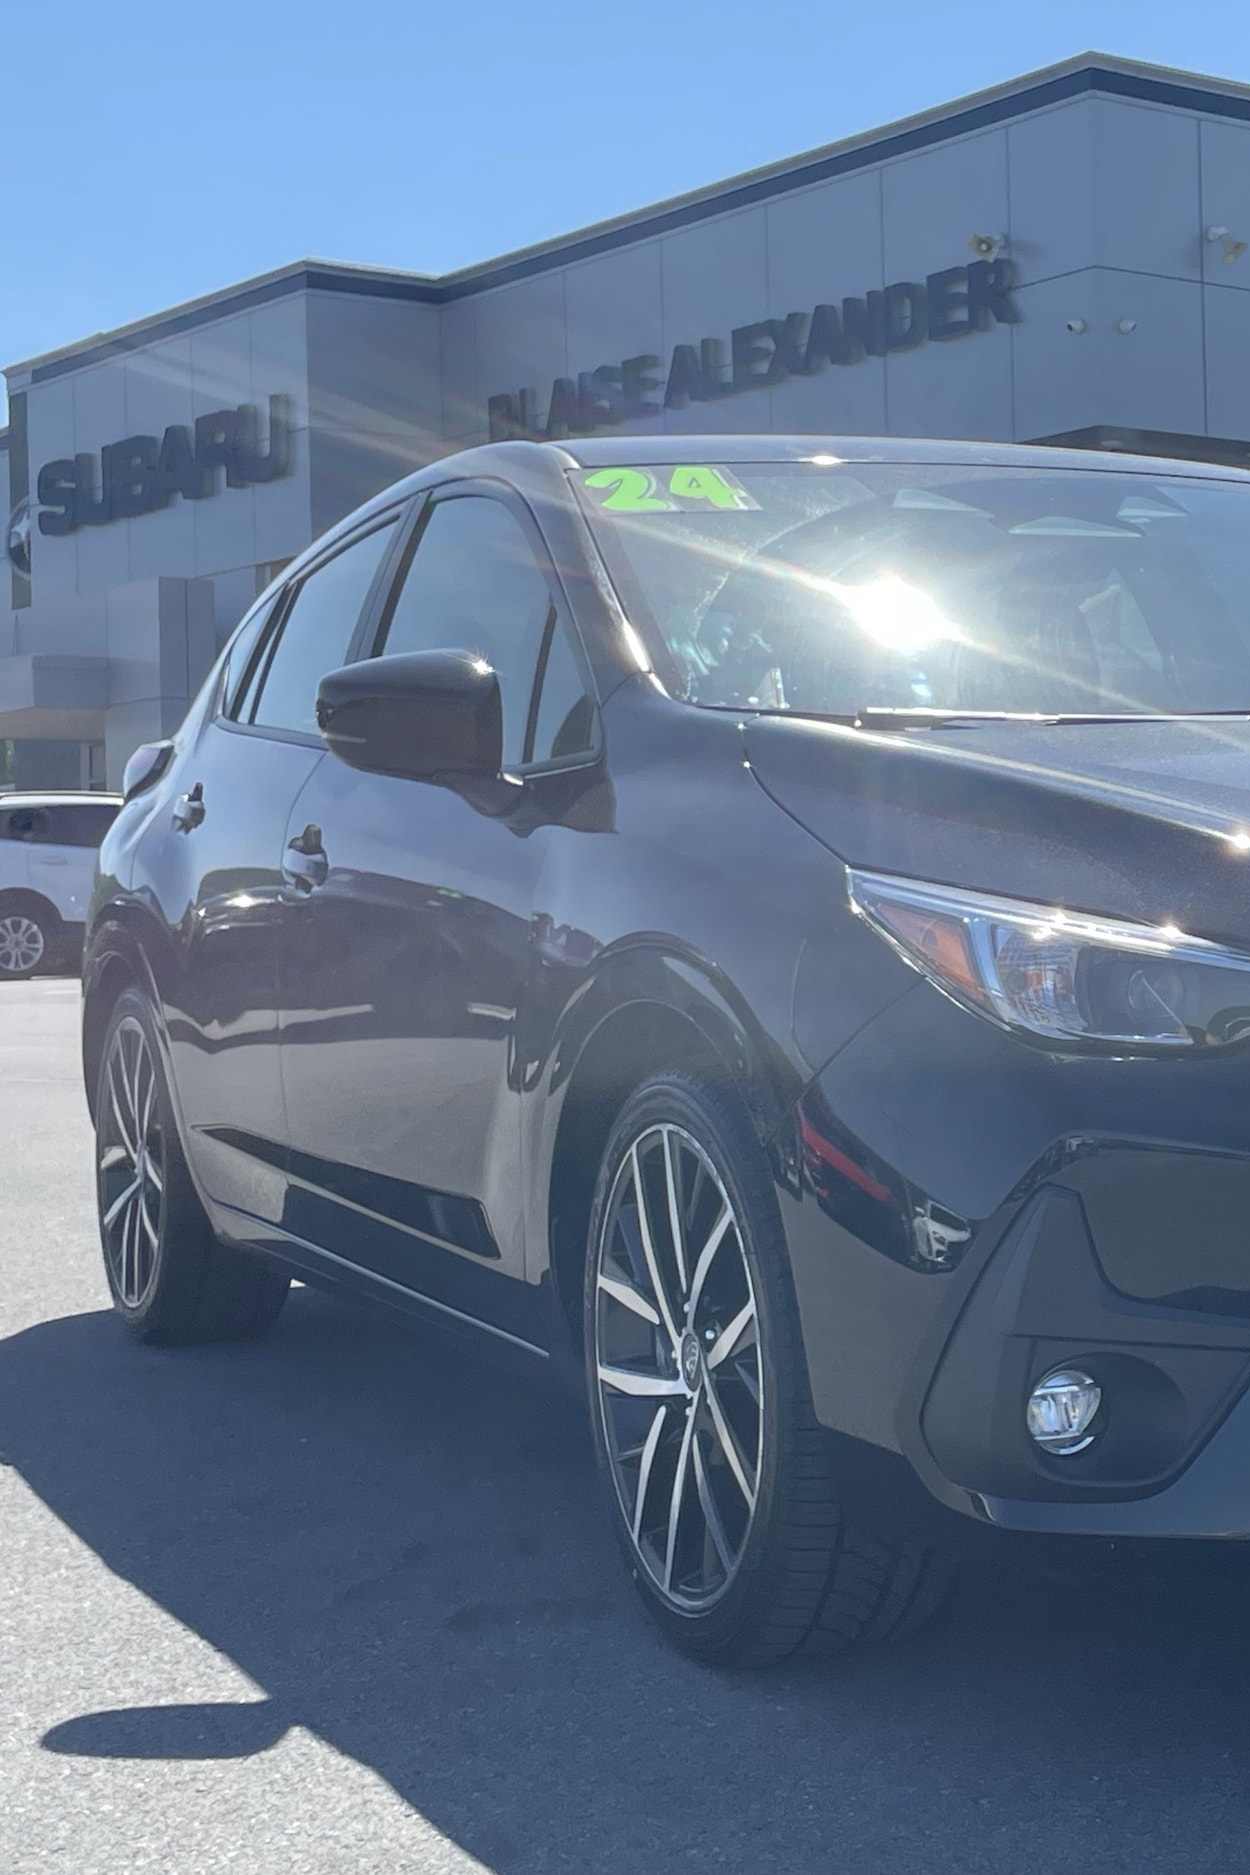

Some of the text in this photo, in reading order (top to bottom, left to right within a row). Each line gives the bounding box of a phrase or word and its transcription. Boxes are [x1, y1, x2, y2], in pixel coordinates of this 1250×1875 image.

[663, 259, 1022, 409] ALEXANDER
[38, 394, 293, 536] SUBARU
[584, 466, 749, 512] 24
